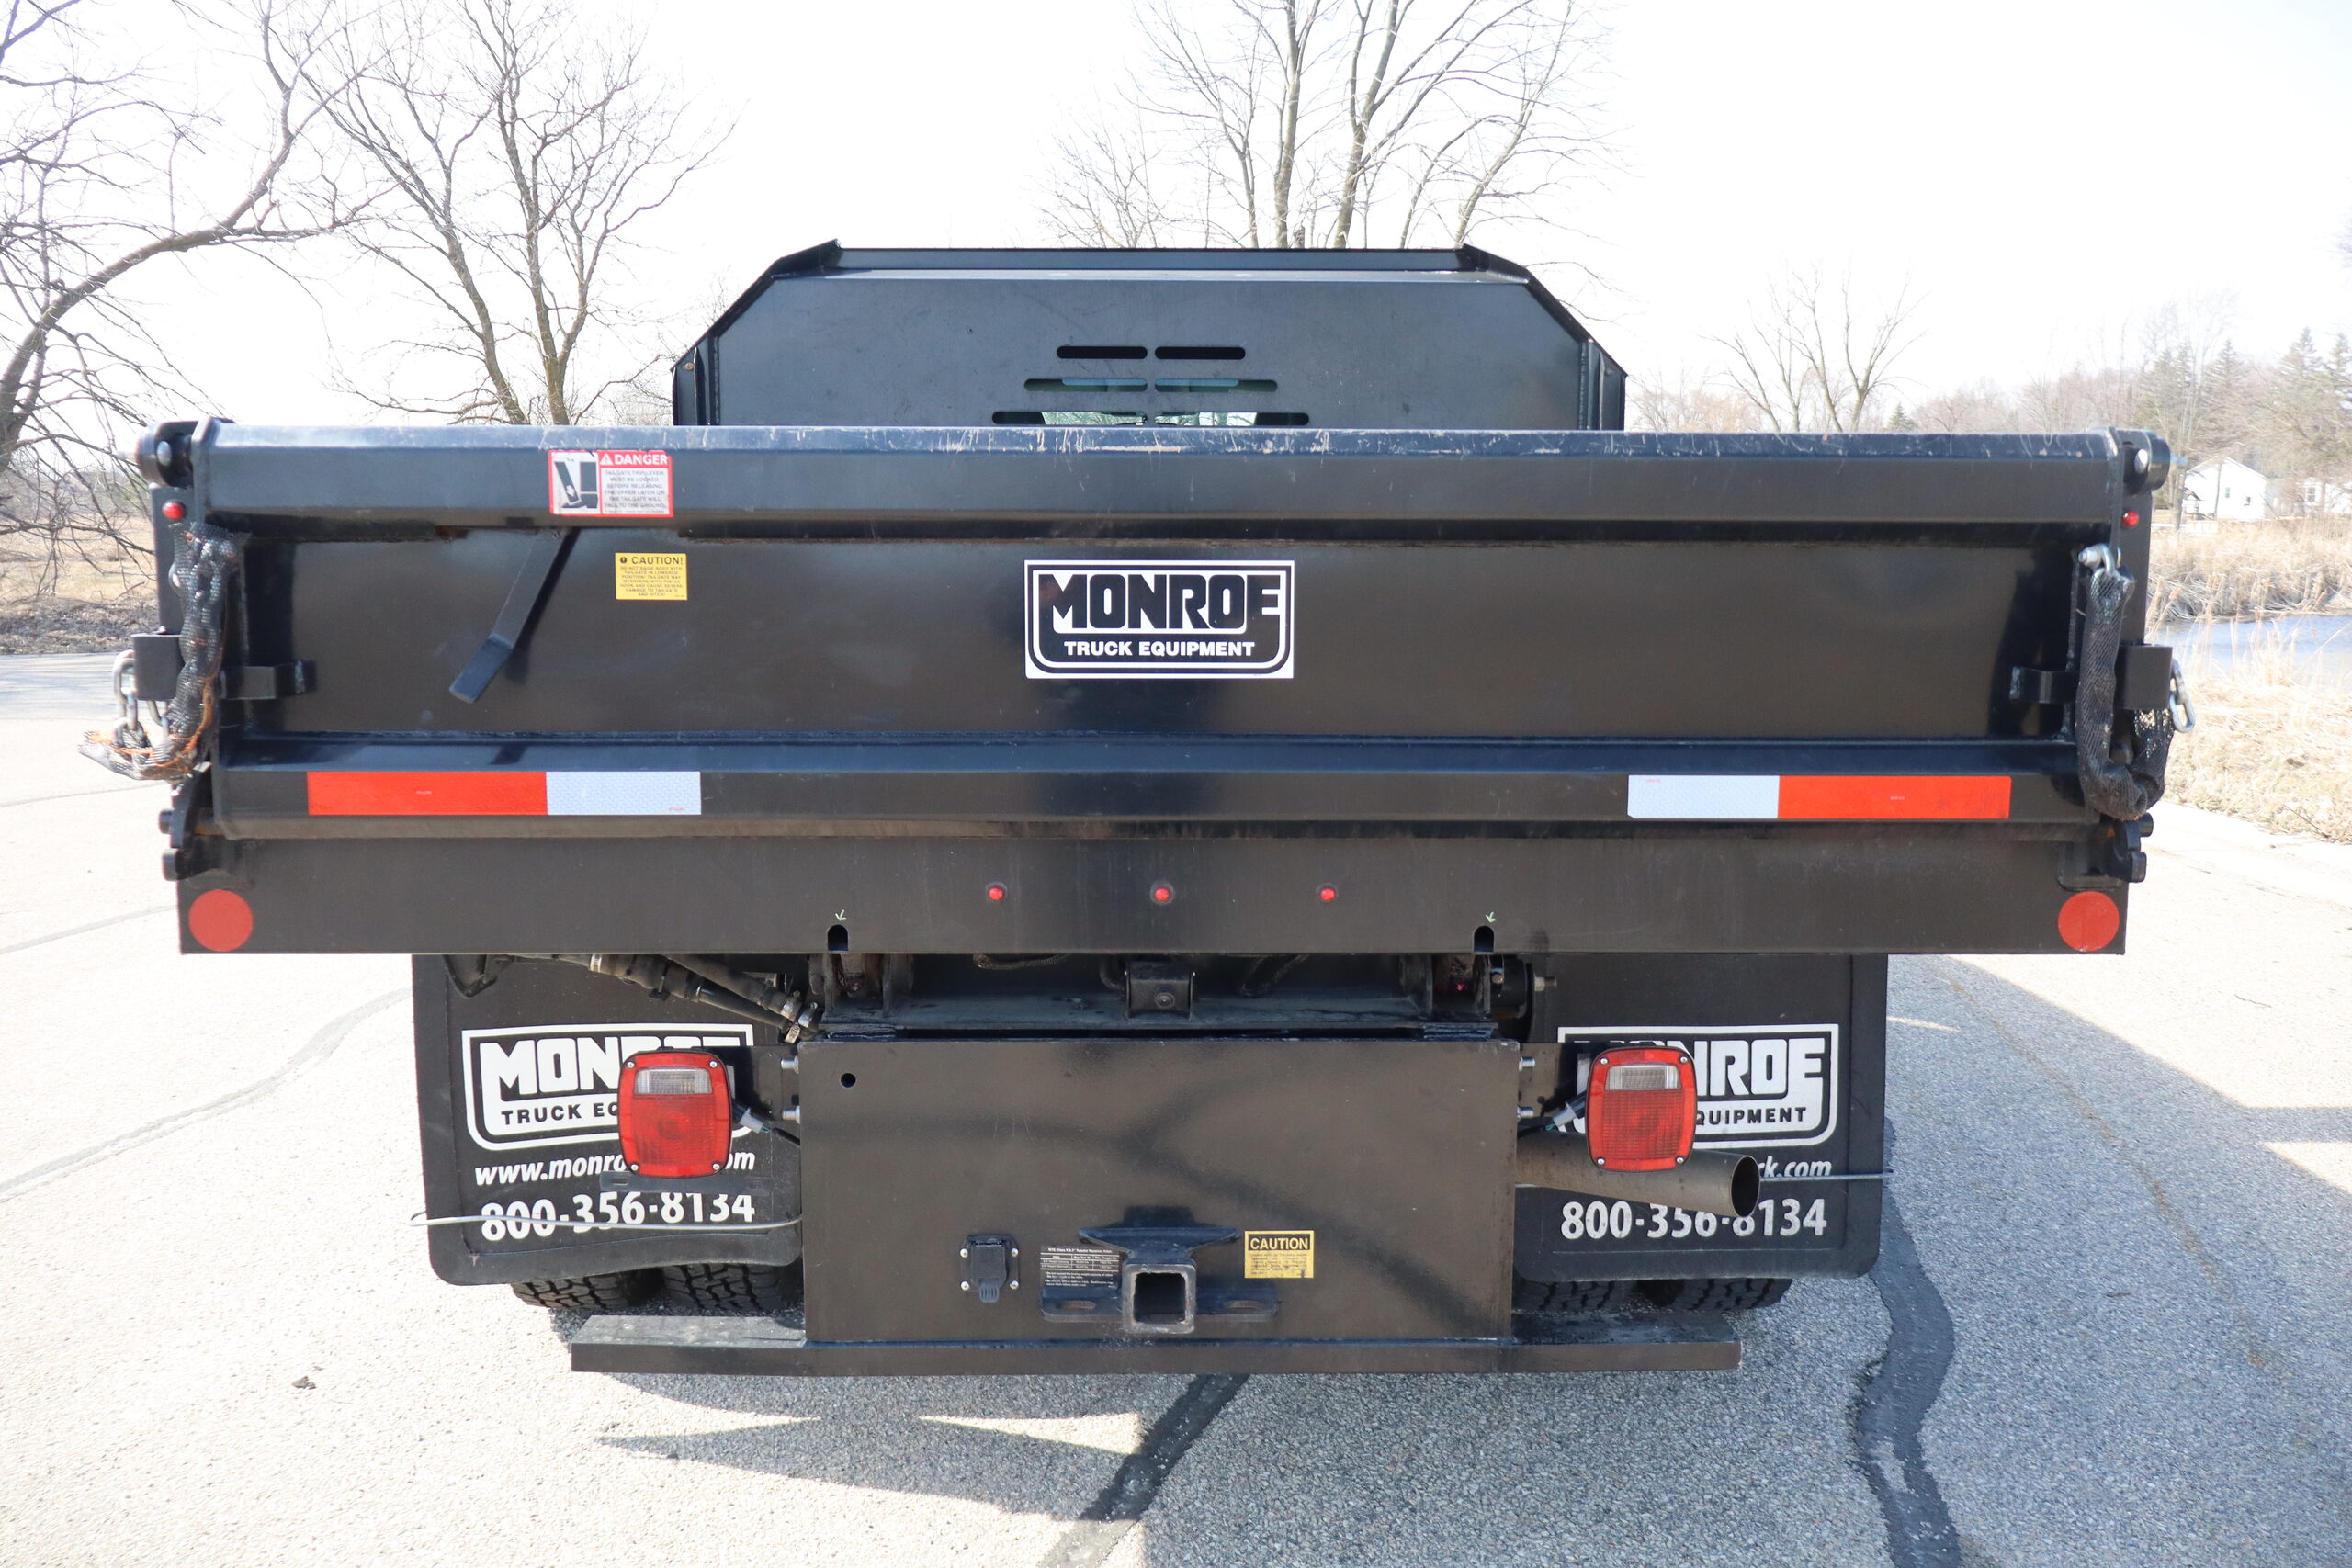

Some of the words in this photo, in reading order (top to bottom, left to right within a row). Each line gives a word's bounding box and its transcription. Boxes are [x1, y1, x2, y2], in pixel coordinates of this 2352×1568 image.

[614, 453, 669, 465] DANGER
[1038, 573, 1282, 629] MONROE
[1064, 641, 1133, 657] TRUCK
[1138, 641, 1255, 657] EQUIPMENT
[479, 1036, 740, 1095] MON
[501, 1104, 582, 1125] TRUCK
[1696, 1106, 1806, 1126] QUIPMENT
[481, 1190, 755, 1241] 800-356-8134
[1561, 1198, 1827, 1240] 800-356-8134
[1250, 1237, 1308, 1250] CAUTION
